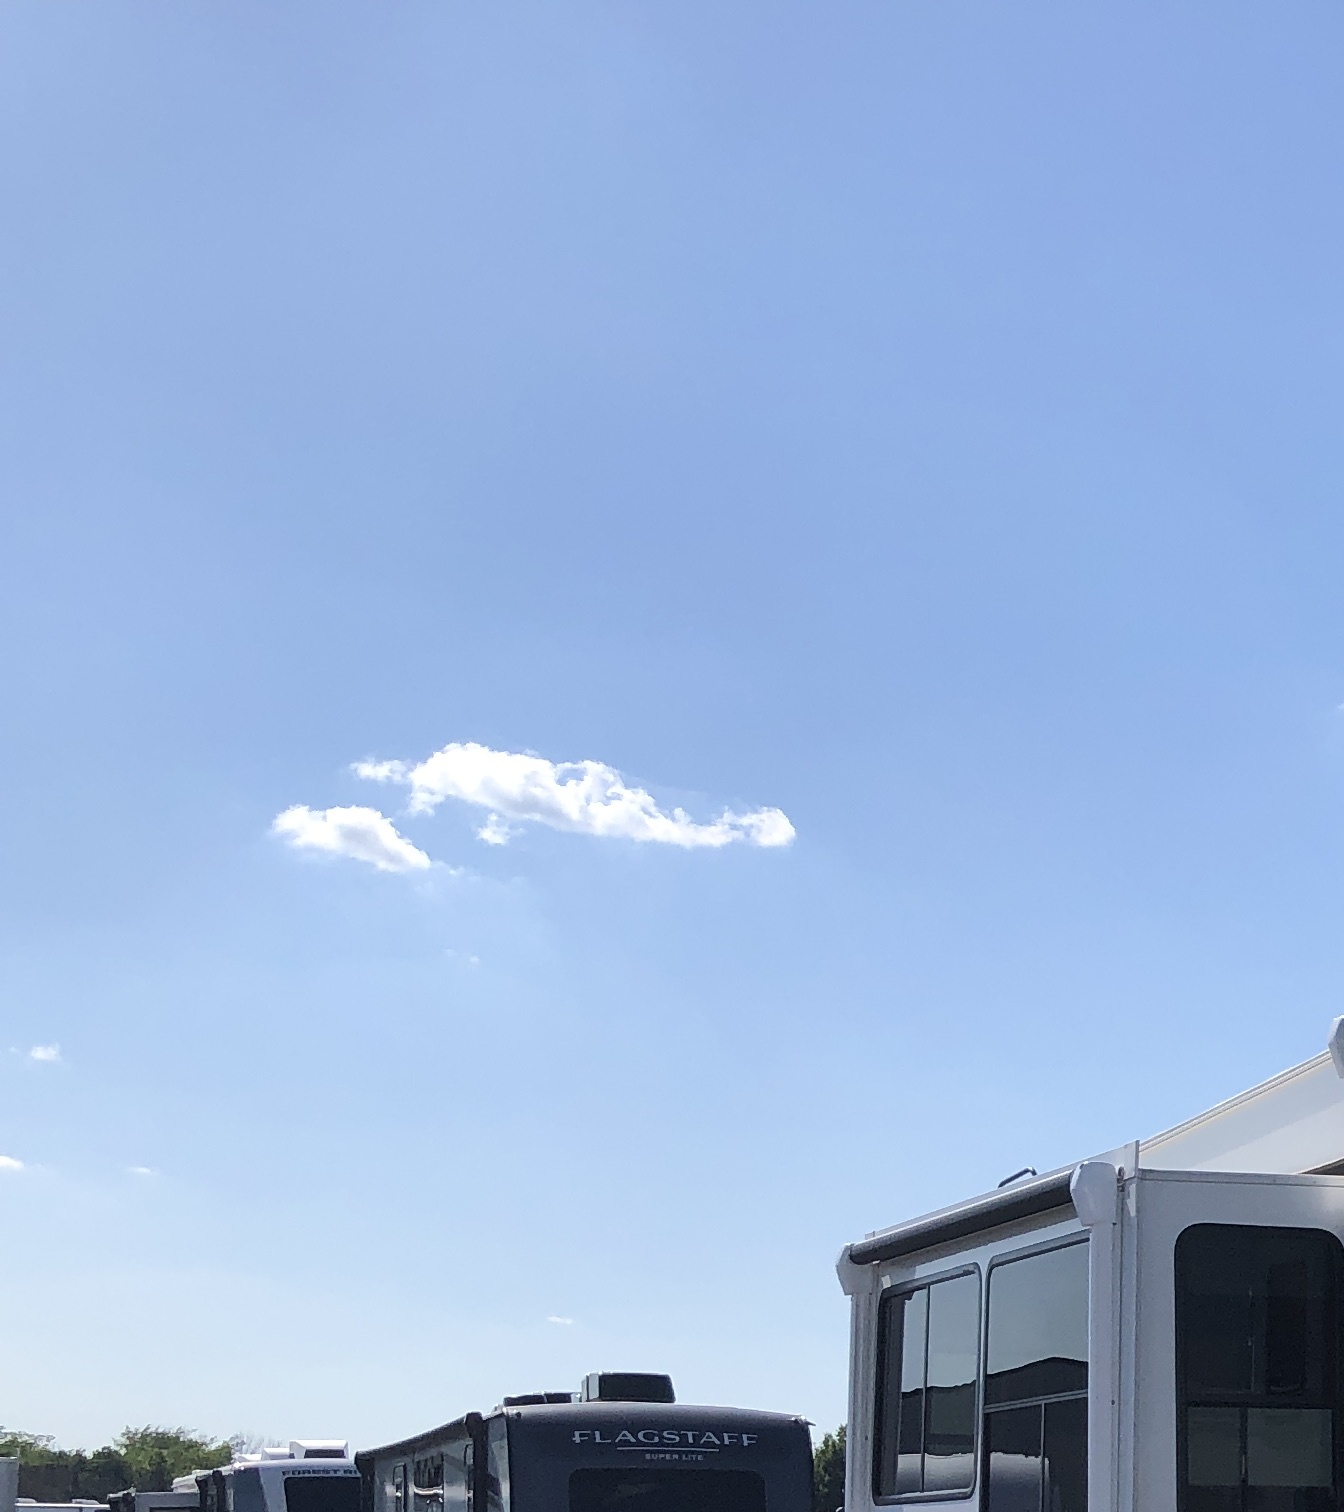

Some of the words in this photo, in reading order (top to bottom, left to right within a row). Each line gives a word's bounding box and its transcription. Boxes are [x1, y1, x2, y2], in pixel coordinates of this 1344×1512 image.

[572, 1429, 759, 1447] FLAGSTAFF
[645, 1453, 679, 1461] SUPER
[682, 1454, 704, 1462] LITE
